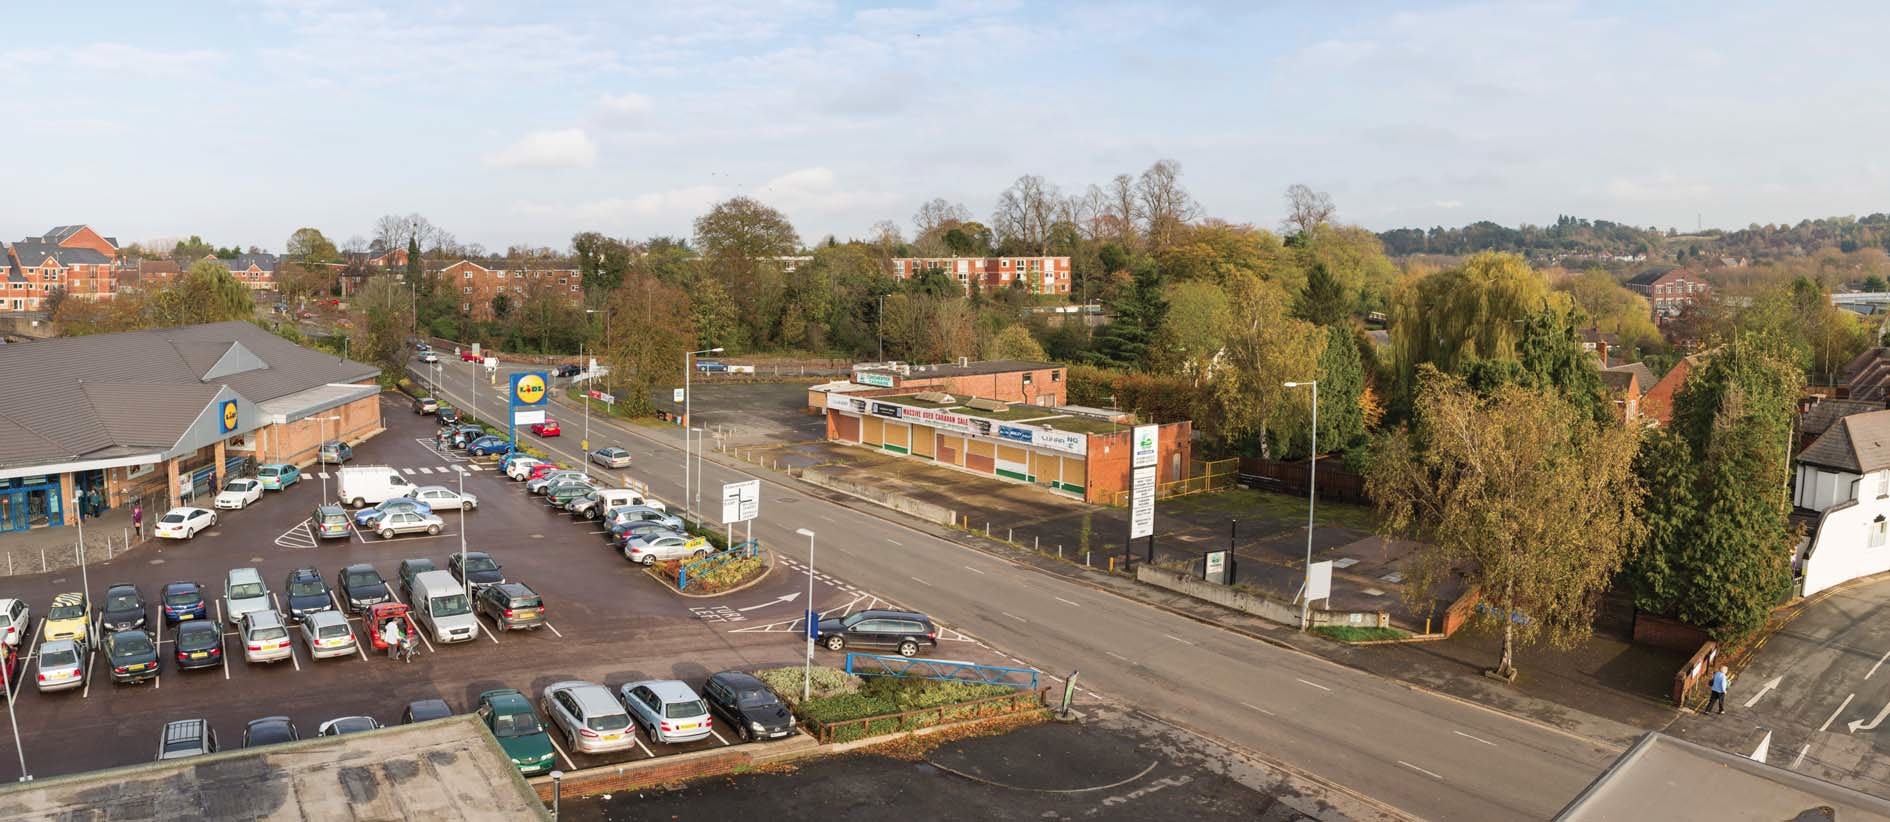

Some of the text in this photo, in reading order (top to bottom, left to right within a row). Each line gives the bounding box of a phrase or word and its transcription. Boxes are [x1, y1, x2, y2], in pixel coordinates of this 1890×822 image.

[903, 408, 921, 417] MASSIVE
[923, 411, 934, 419] USED
[935, 413, 955, 423] CARAVAN
[957, 417, 968, 425] SALE
[689, 607, 727, 622] LEFT
[711, 605, 747, 622] TURN
